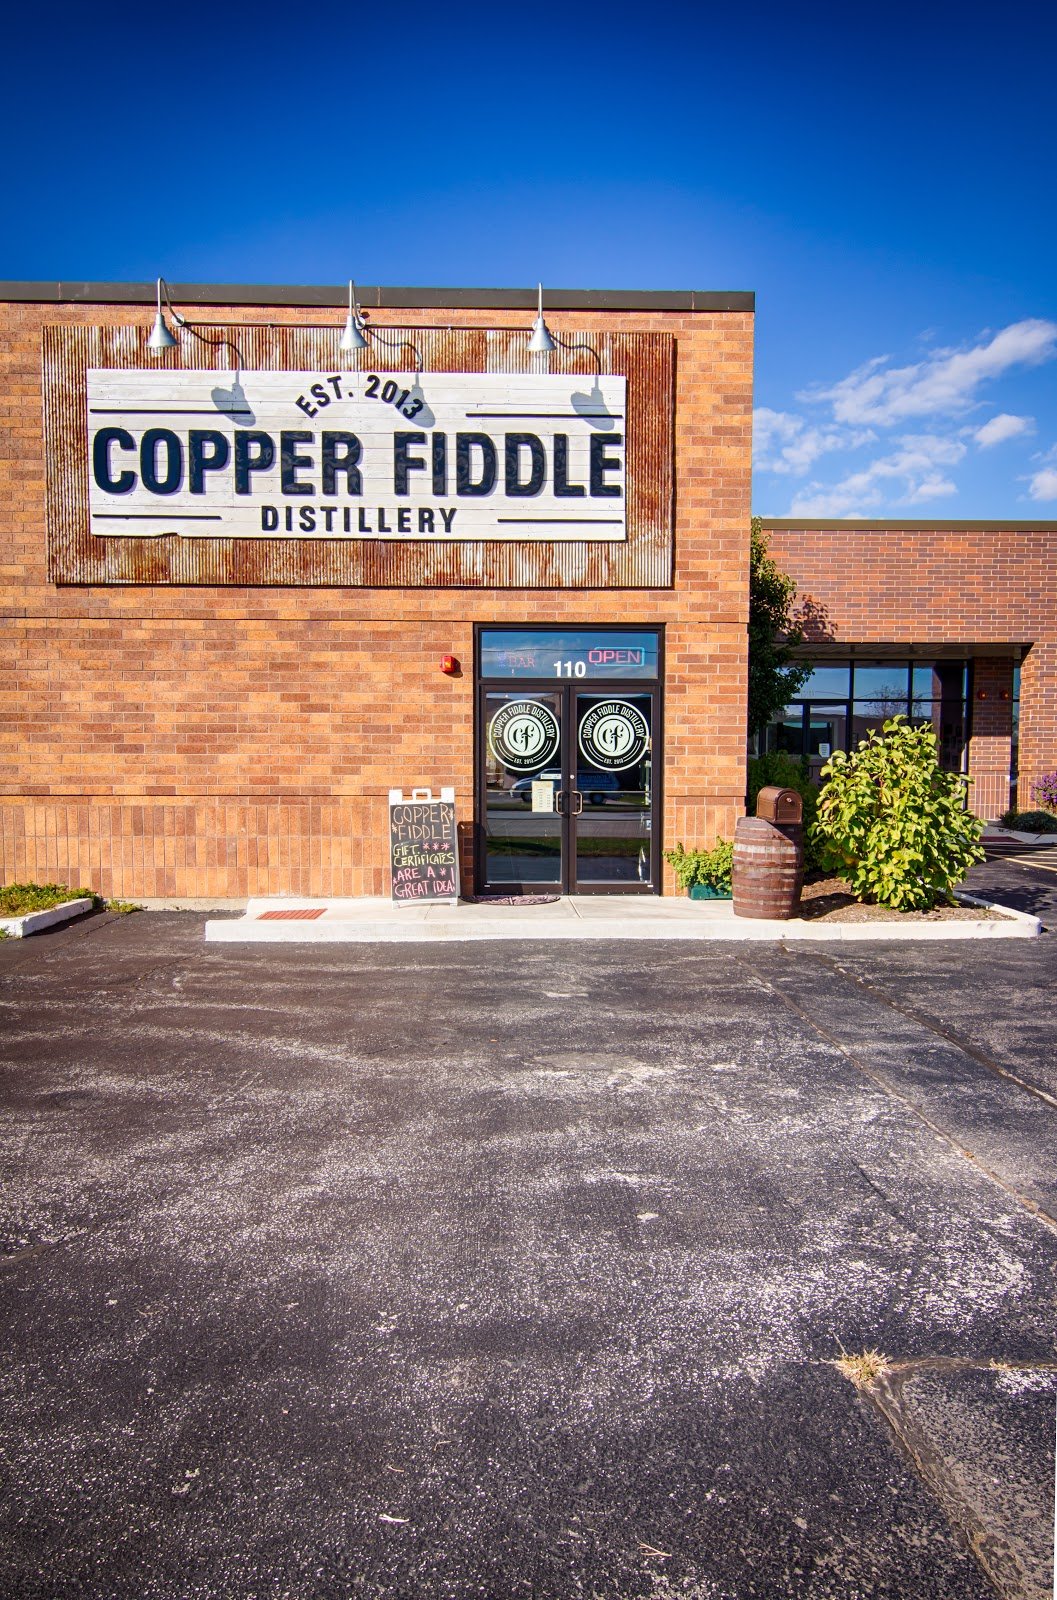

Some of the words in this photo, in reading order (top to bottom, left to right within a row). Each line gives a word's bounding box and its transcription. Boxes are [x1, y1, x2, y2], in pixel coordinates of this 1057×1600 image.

[295, 375, 353, 418] EST.
[365, 375, 424, 419] 2013
[92, 426, 363, 495] COPPER
[393, 431, 624, 497] FIDDLE
[261, 507, 457, 533] DISTILLERY
[588, 650, 641, 663] OPEN
[553, 660, 587, 678] 110
[493, 712, 511, 738] COPPER
[507, 704, 531, 717] FIDDLE
[531, 706, 556, 738] DISTILLERY
[583, 712, 600, 739] COPPER
[596, 704, 621, 717] FIDDLE
[620, 706, 646, 738] DISTILLERY
[393, 804, 450, 825] COPPER
[398, 824, 452, 840] FIDDLE
[397, 867, 421, 882] ARE
[427, 866, 436, 878] A
[394, 880, 430, 898] GREAT
